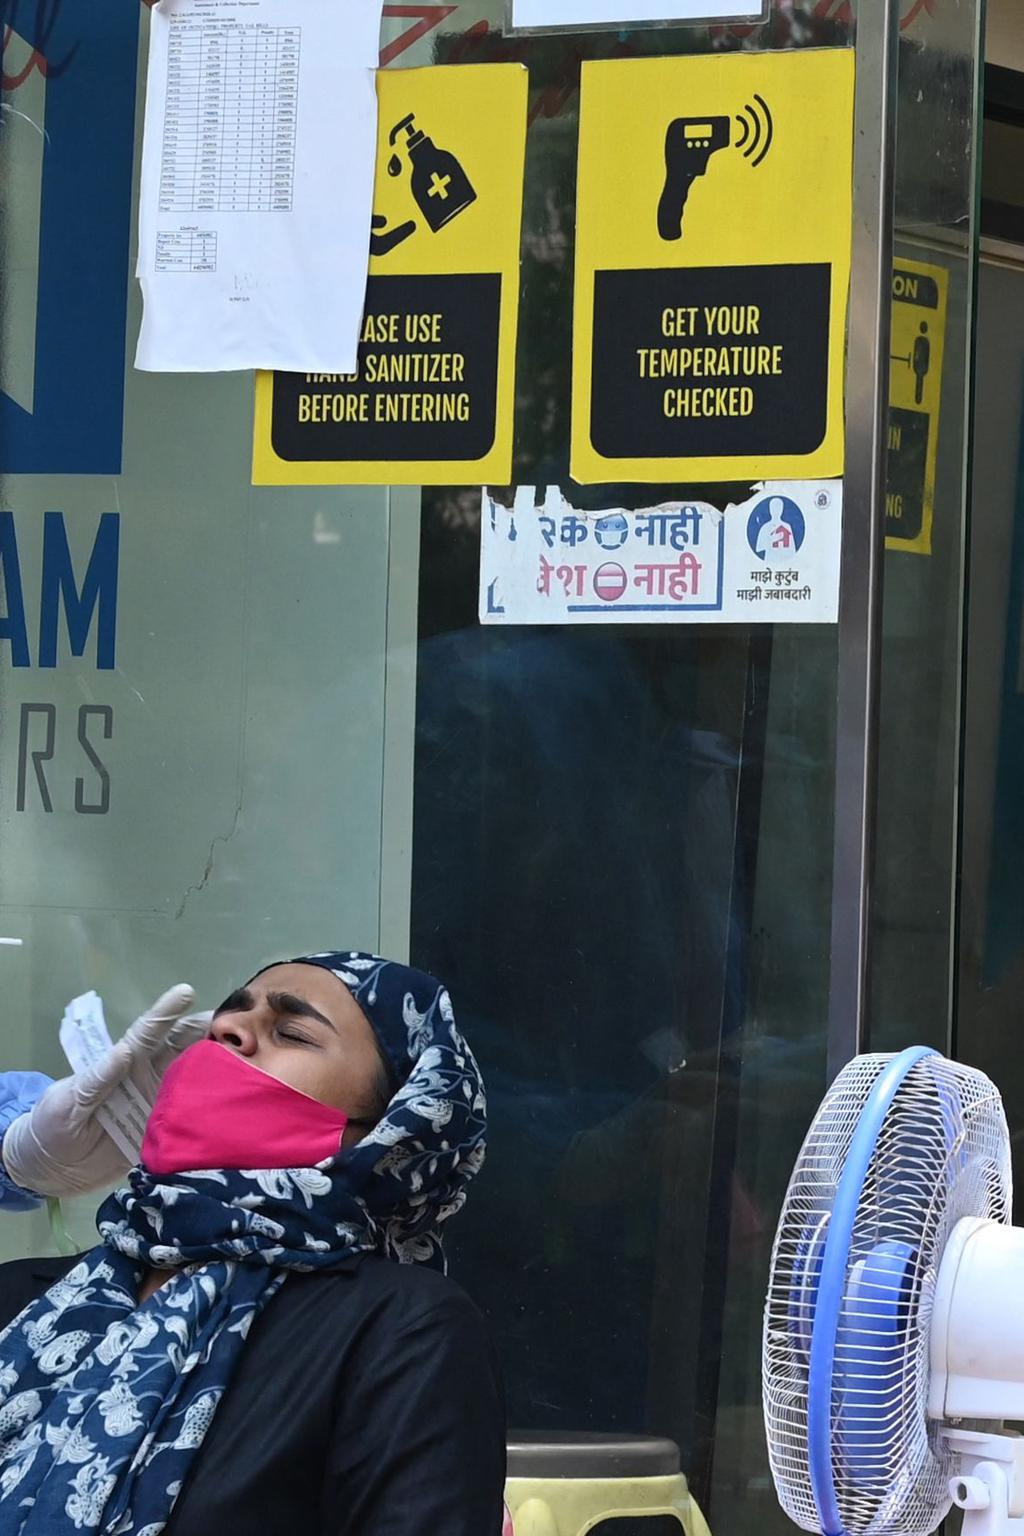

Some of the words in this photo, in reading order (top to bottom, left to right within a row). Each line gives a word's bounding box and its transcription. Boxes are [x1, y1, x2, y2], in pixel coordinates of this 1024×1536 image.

[360, 314, 400, 343] ASE
[405, 313, 443, 343] USE
[661, 307, 699, 337] GET
[703, 305, 761, 336] YOUR
[365, 353, 465, 384] SANITIZER
[636, 345, 784, 378] TEMPERATURE
[298, 393, 370, 423] BEFORE
[374, 392, 471, 423] ENTERING
[663, 386, 754, 418] CHECKED
[634, 506, 703, 551] नाही
[633, 552, 703, 601] नाही
[750, 567, 773, 584] माझे
[736, 585, 762, 602] माझी
